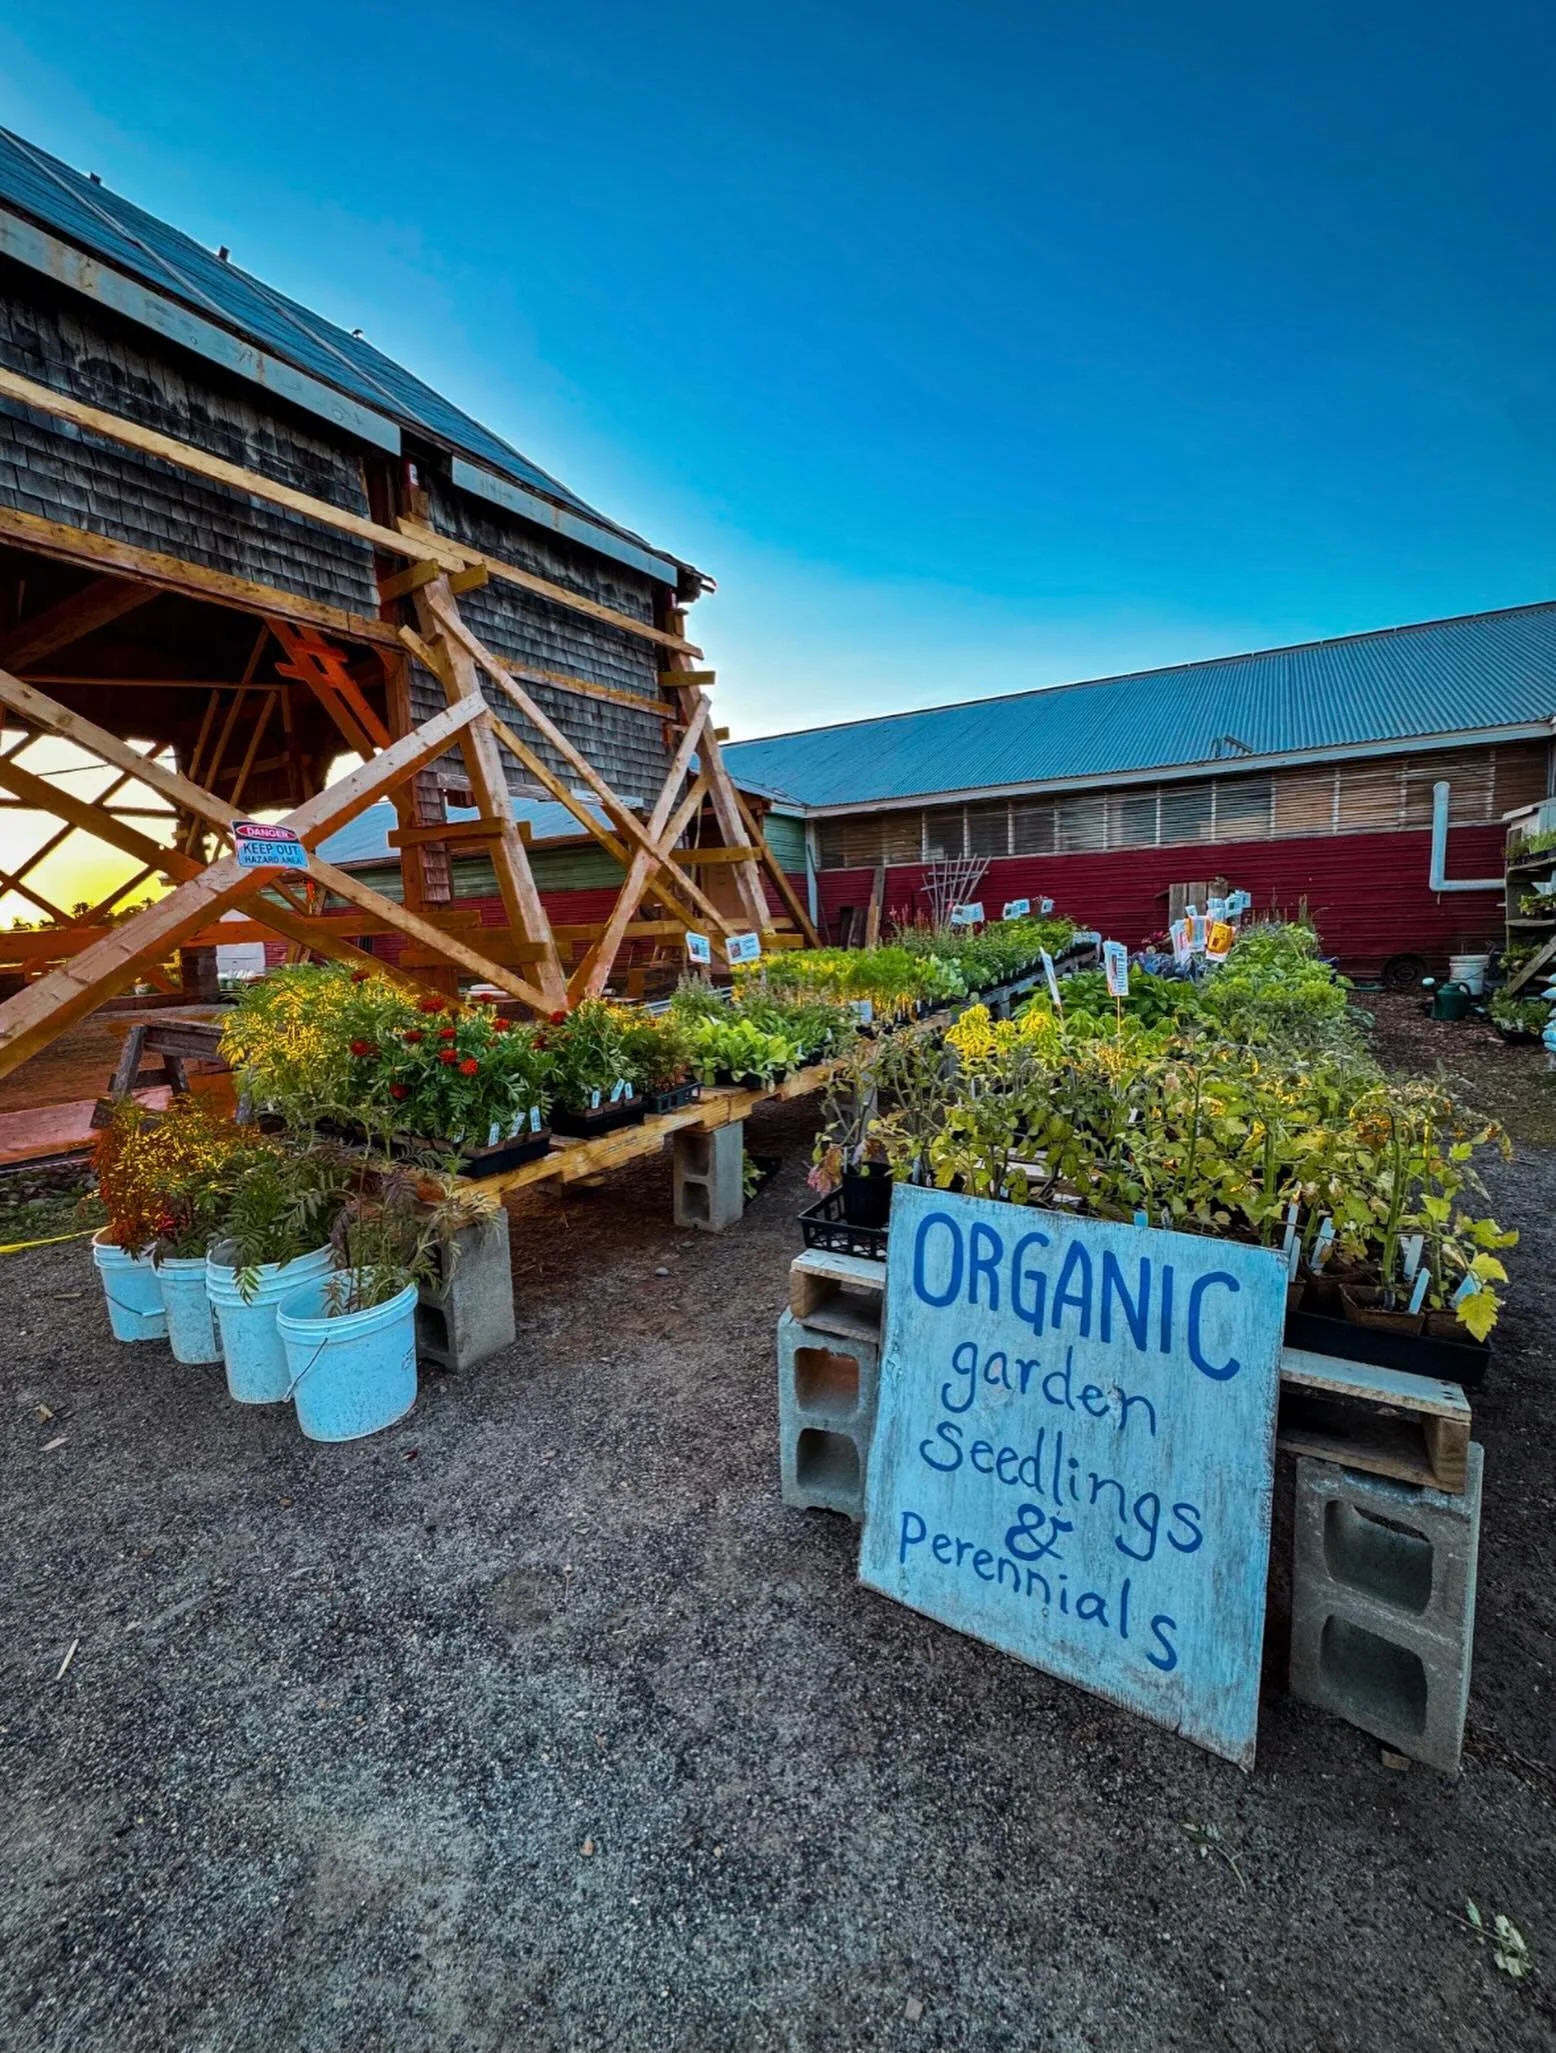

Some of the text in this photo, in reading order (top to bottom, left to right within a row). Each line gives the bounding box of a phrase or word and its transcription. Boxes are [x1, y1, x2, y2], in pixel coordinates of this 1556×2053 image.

[243, 842, 298, 856] KEEP OUT
[246, 826, 288, 838] DANGER
[244, 855, 280, 864] HAZARD
[912, 1211, 1241, 1381] ORGANIC
[941, 1341, 1156, 1437] garden
[1004, 1503, 1074, 1561] &
